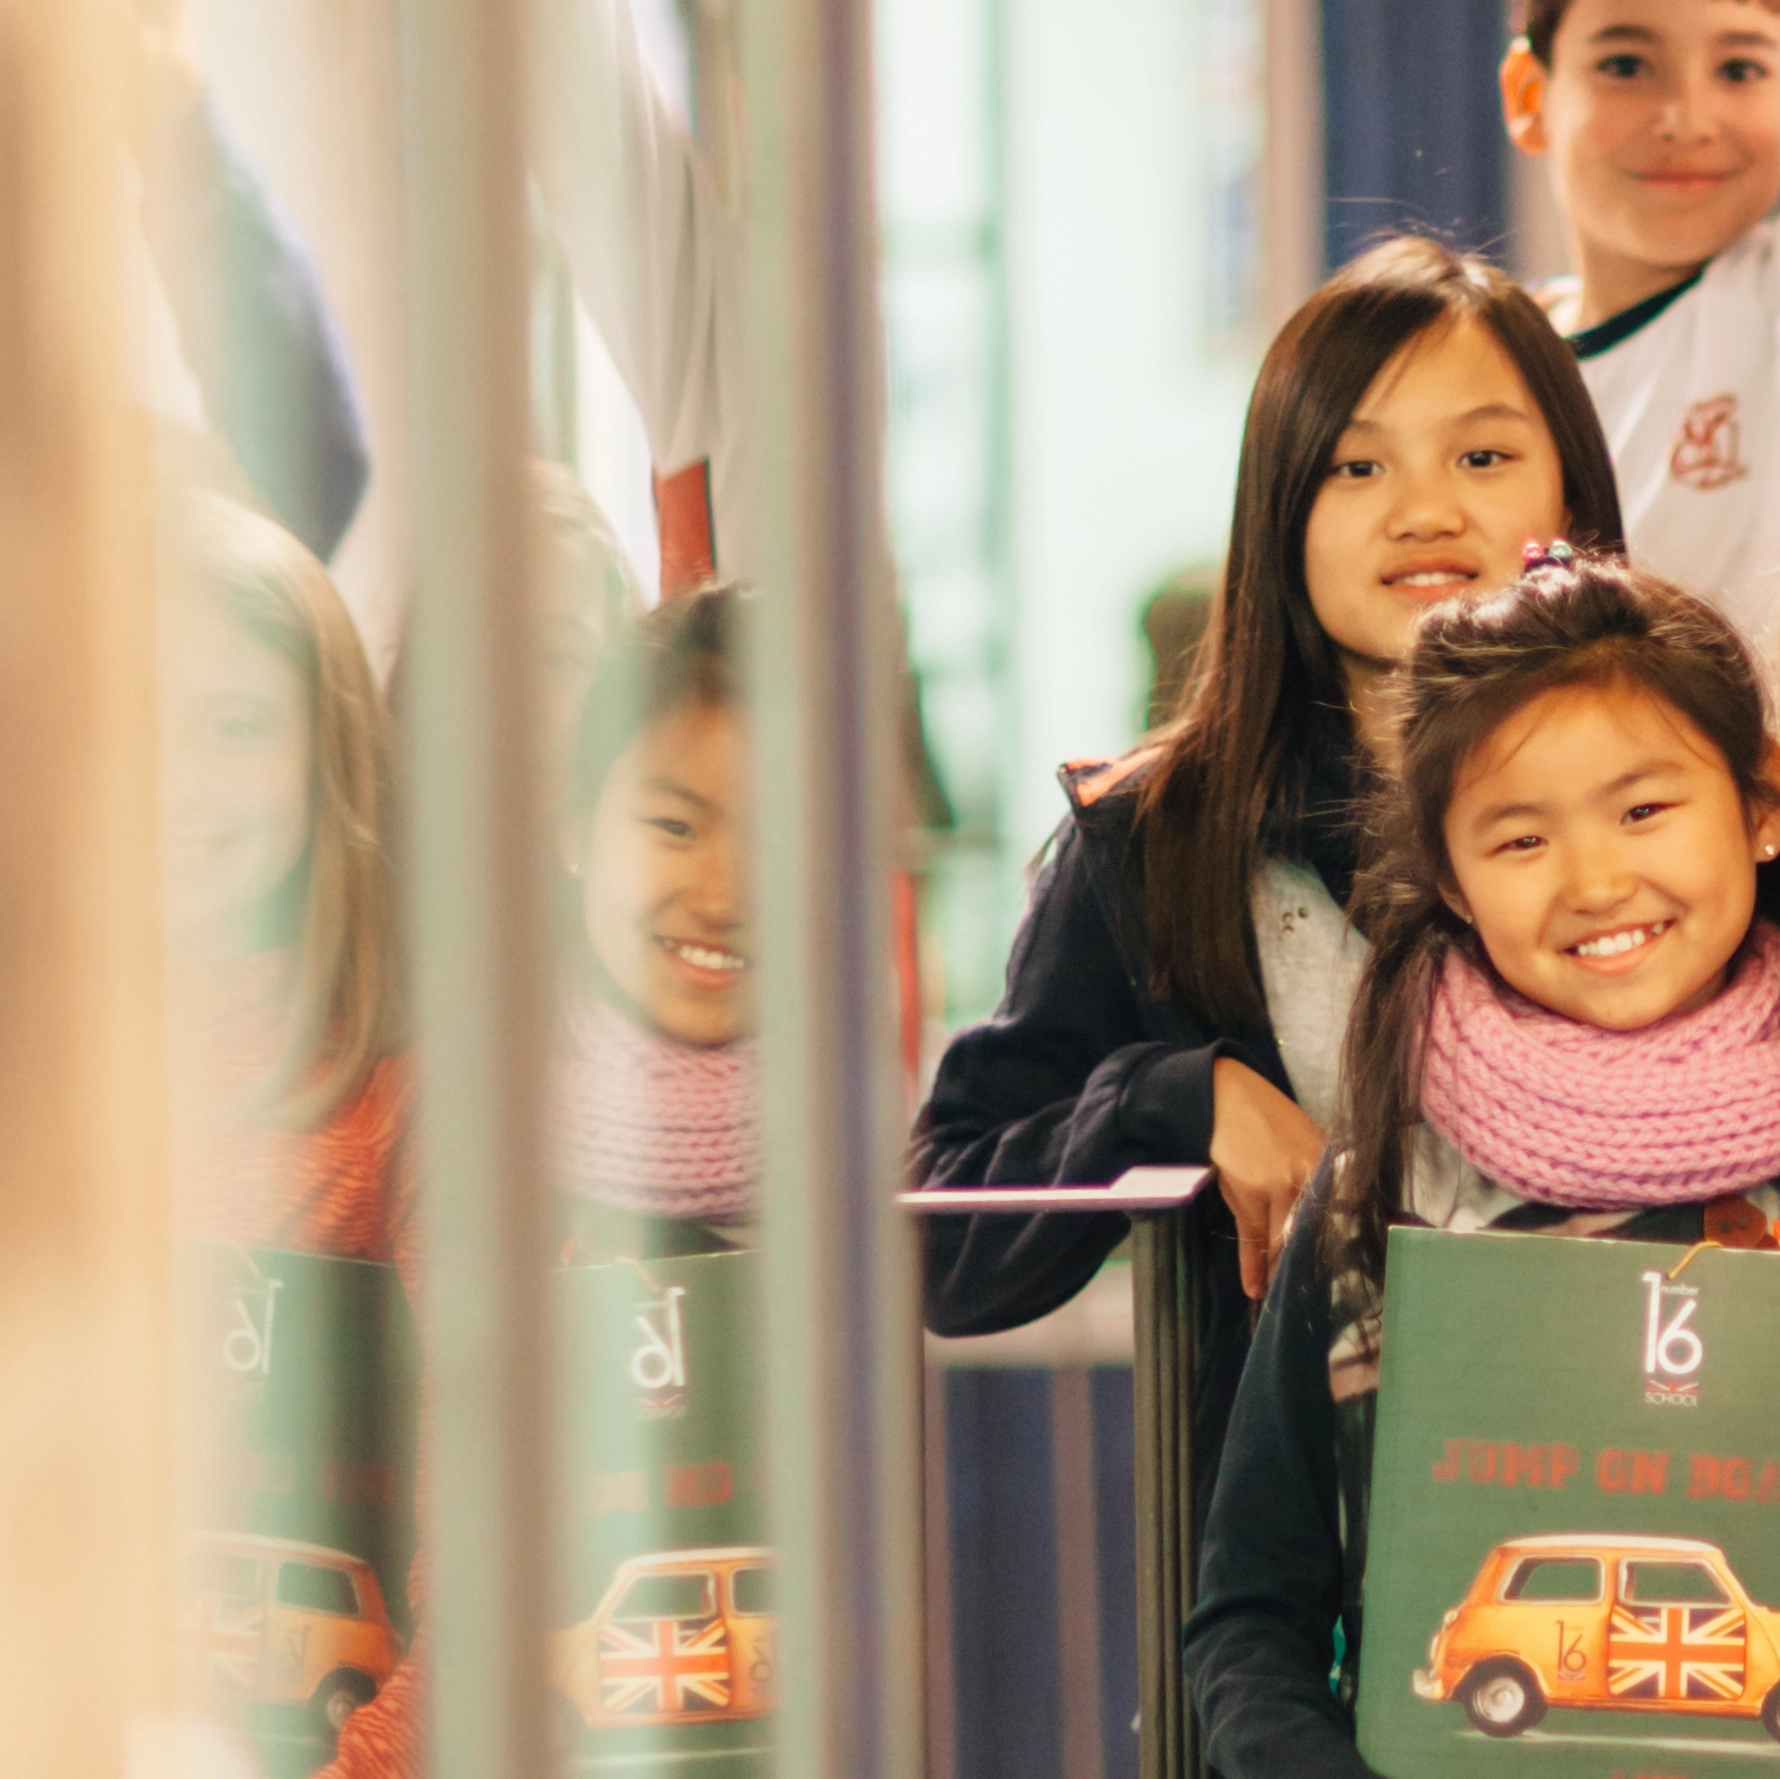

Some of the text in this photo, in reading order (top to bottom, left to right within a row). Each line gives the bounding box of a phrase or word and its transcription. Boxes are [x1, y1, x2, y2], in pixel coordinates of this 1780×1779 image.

[1642, 1271, 1702, 1374] 16
[1432, 1437, 1580, 1490] JUMP
[1597, 1447, 1669, 1496] ON
[1555, 1620, 1588, 1672] 16
